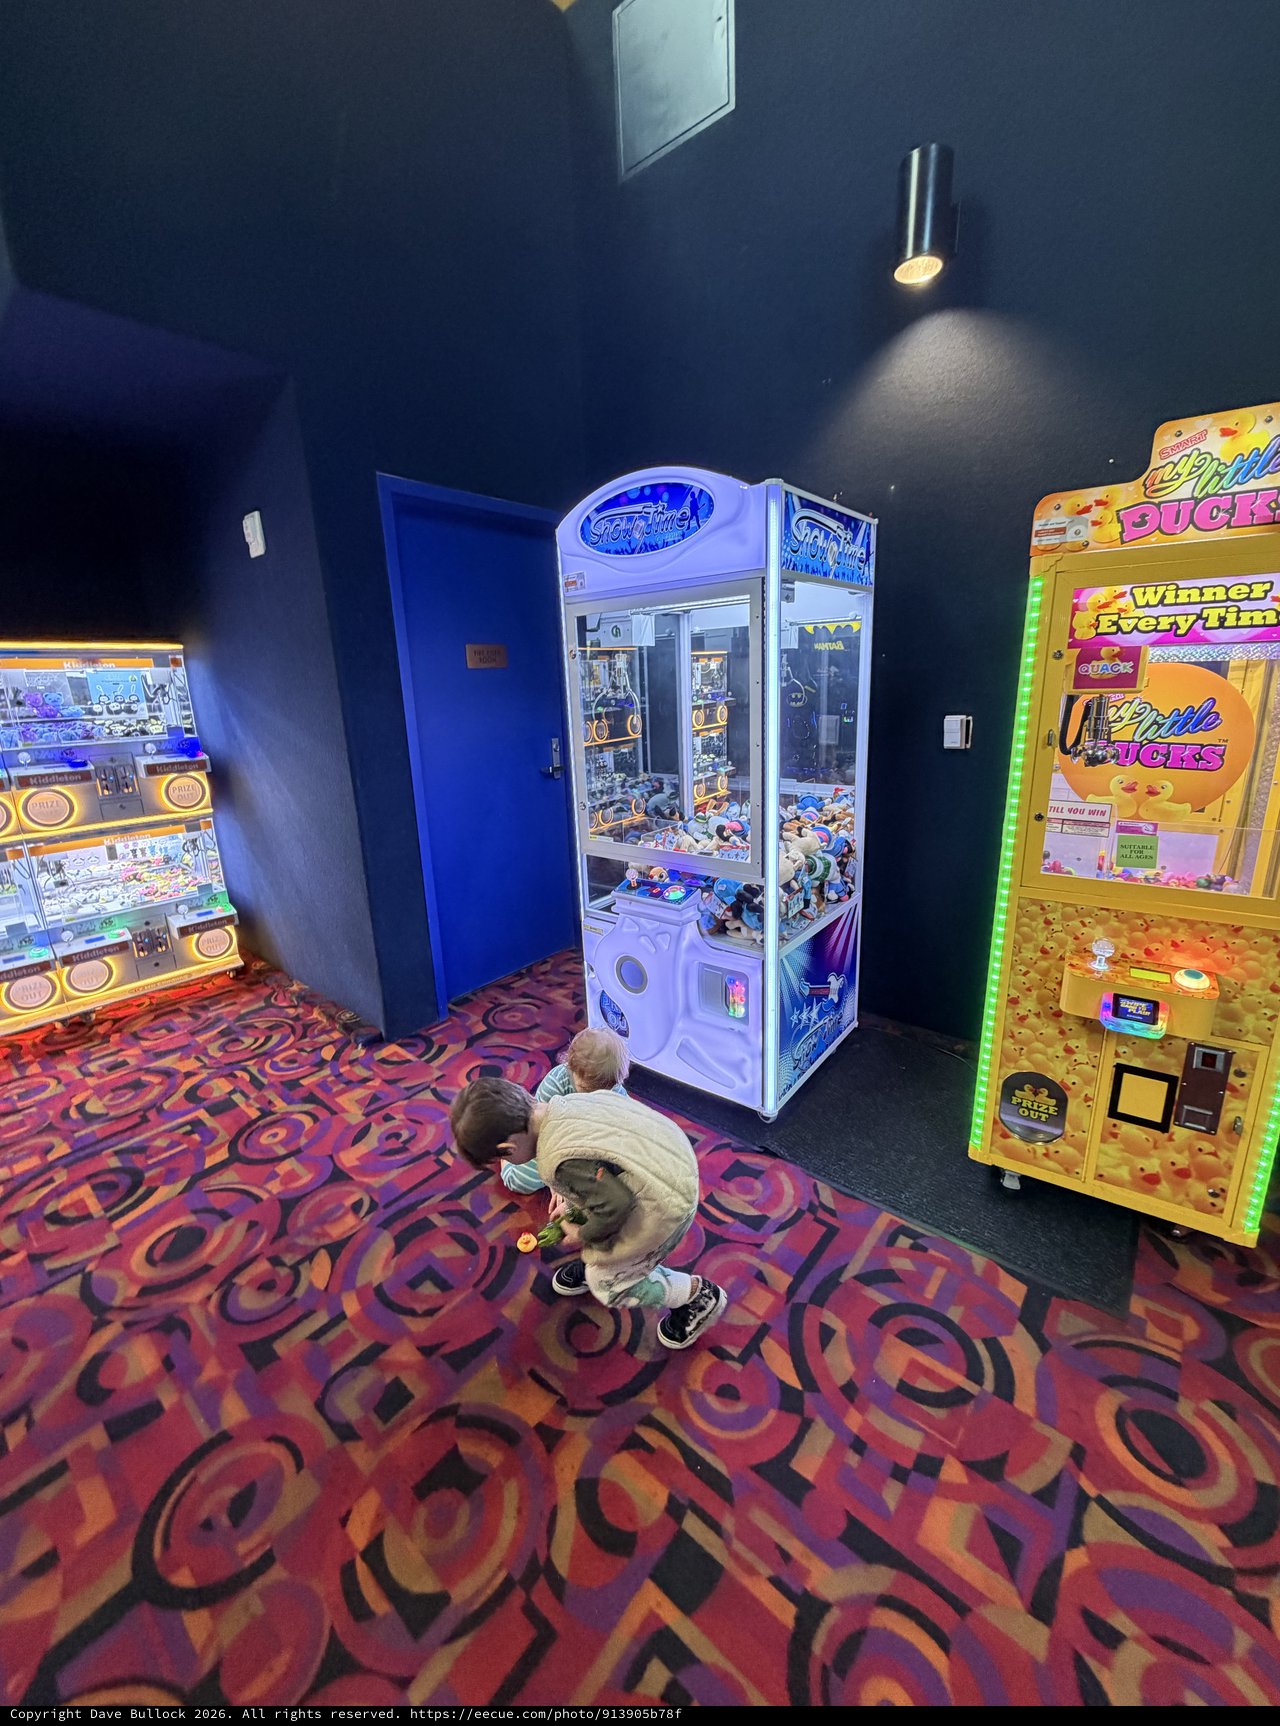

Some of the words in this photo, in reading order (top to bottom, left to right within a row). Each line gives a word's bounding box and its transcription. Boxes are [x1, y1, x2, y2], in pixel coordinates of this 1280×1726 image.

[1159, 429, 1208, 460] SMART
[1144, 449, 1212, 498] my
[1119, 490, 1280, 542] DUCK
[1132, 582, 1272, 607] Winner
[1098, 613, 1197, 636] Every
[1203, 607, 1280, 629] Tim
[1079, 661, 1134, 675] QUACK
[1133, 697, 1223, 742] little
[1112, 742, 1226, 771] UCKS
[30, 774, 81, 785] Kiddleton
[156, 764, 199, 773] Kiddleton
[1049, 806, 1064, 814] TILL
[1067, 807, 1085, 815] YOU
[1088, 809, 1107, 817] WIN
[72, 945, 120, 962] Kiddleton
[1011, 1096, 1058, 1115] PRIZE
[1019, 1108, 1049, 1122] OUT
